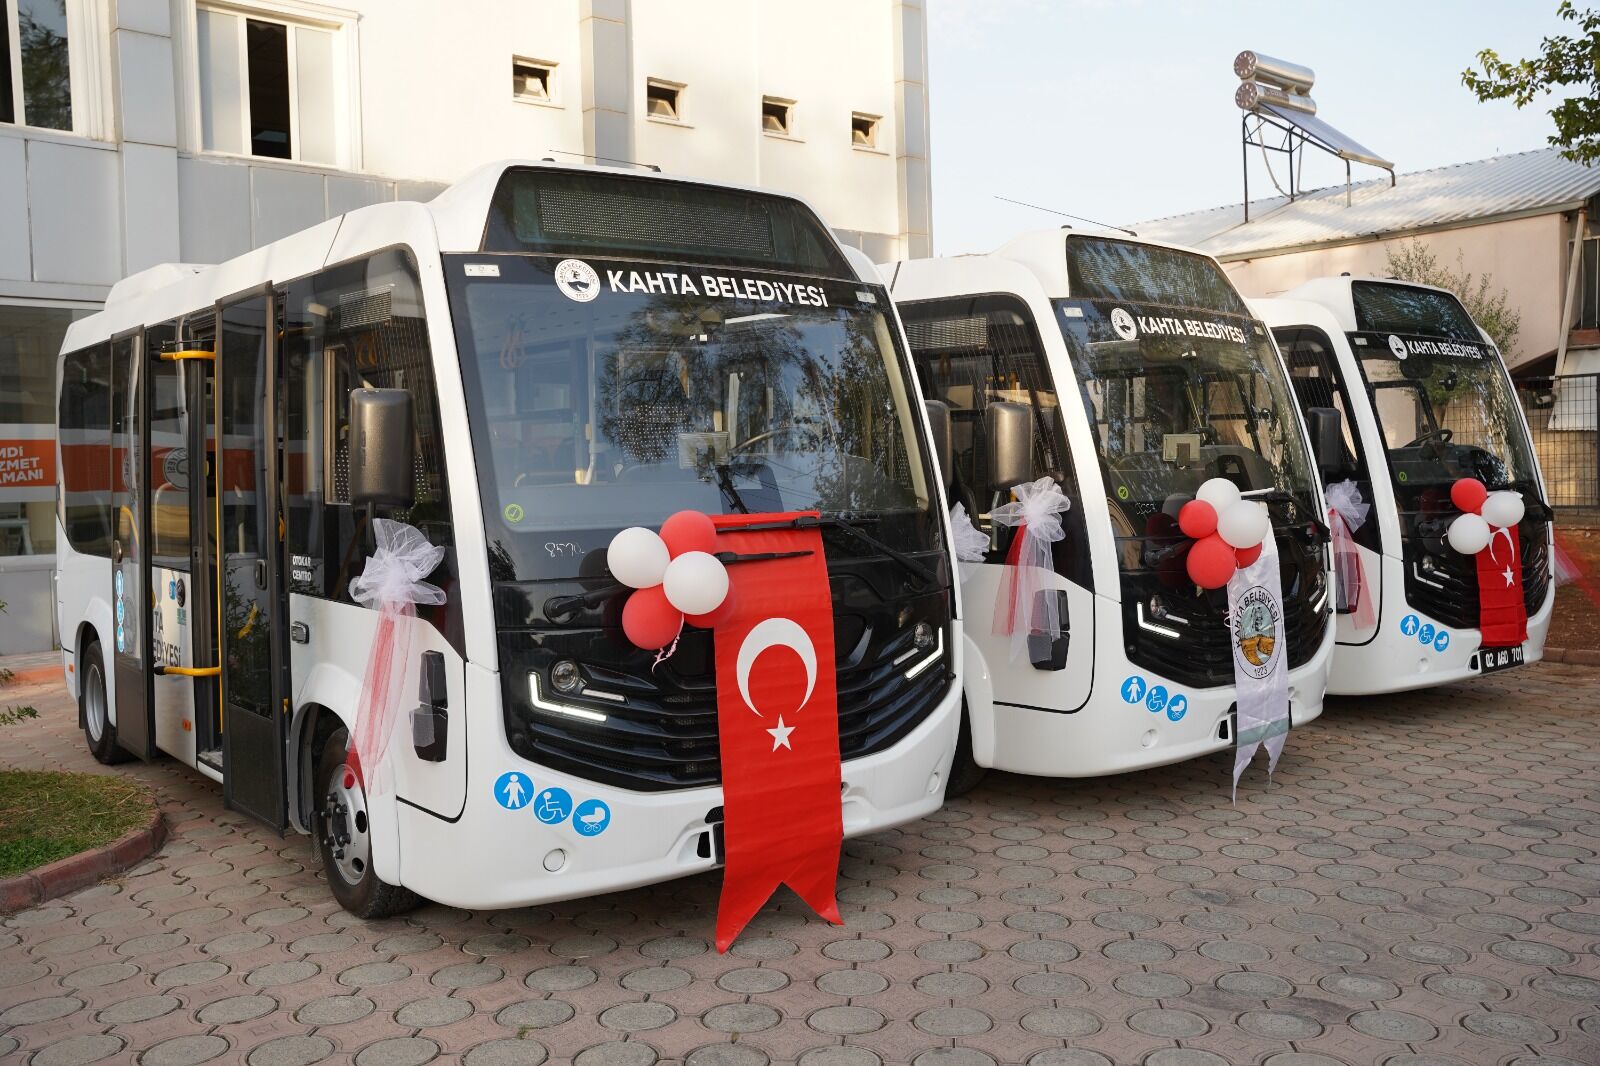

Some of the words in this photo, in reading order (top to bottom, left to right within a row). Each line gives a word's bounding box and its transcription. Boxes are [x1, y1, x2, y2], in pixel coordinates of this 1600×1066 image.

[607, 270, 700, 296] KAHTA
[1137, 316, 1187, 336] KAHTA
[1406, 340, 1440, 355] KAHTA
[1485, 652, 1495, 668] 02
[1254, 666, 1268, 677] 1923
